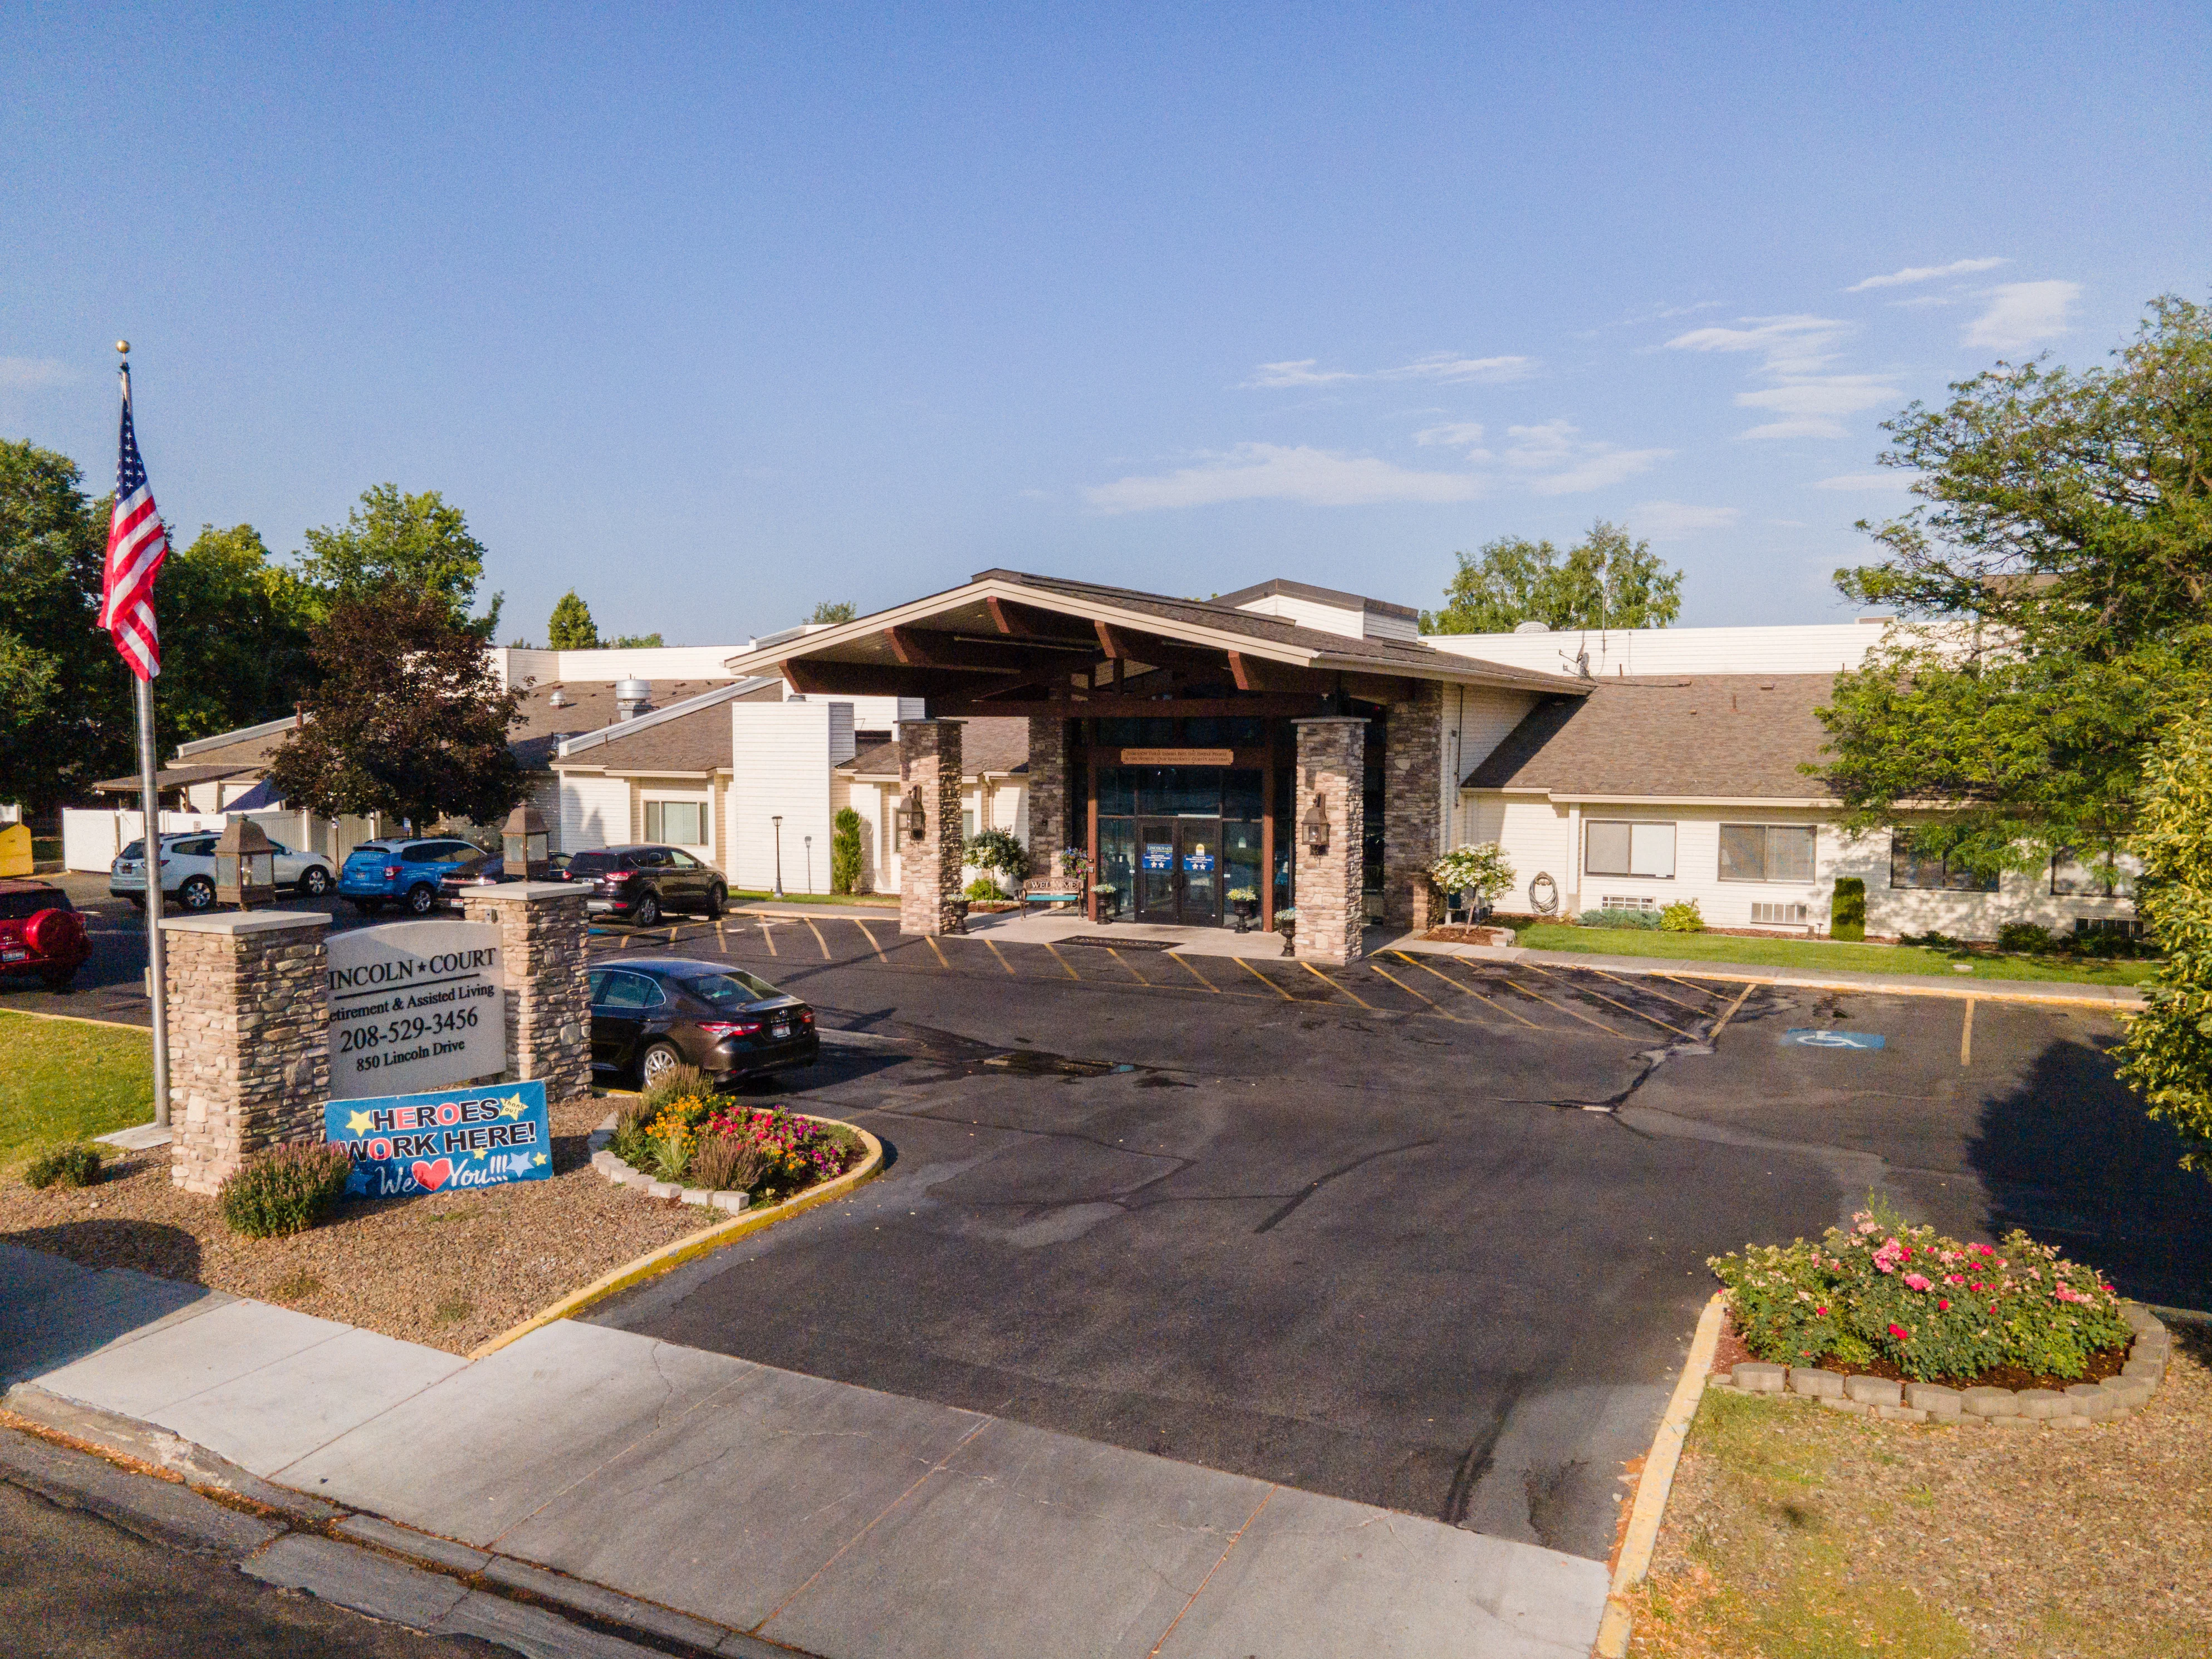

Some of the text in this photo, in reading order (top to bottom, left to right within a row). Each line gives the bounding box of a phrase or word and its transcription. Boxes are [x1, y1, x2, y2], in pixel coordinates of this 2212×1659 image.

[327, 948, 497, 991] INCOLN COURT
[329, 984, 494, 1022] etirement & Assisted Living
[340, 1006, 478, 1053] 208-529-3456
[356, 1039, 465, 1072] 850 Lincoln Drive
[372, 1097, 501, 1132] HEROES
[504, 1099, 524, 1110] Thank
[339, 1121, 537, 1162] WORK HERE!
[375, 1155, 508, 1195] We You!!!
